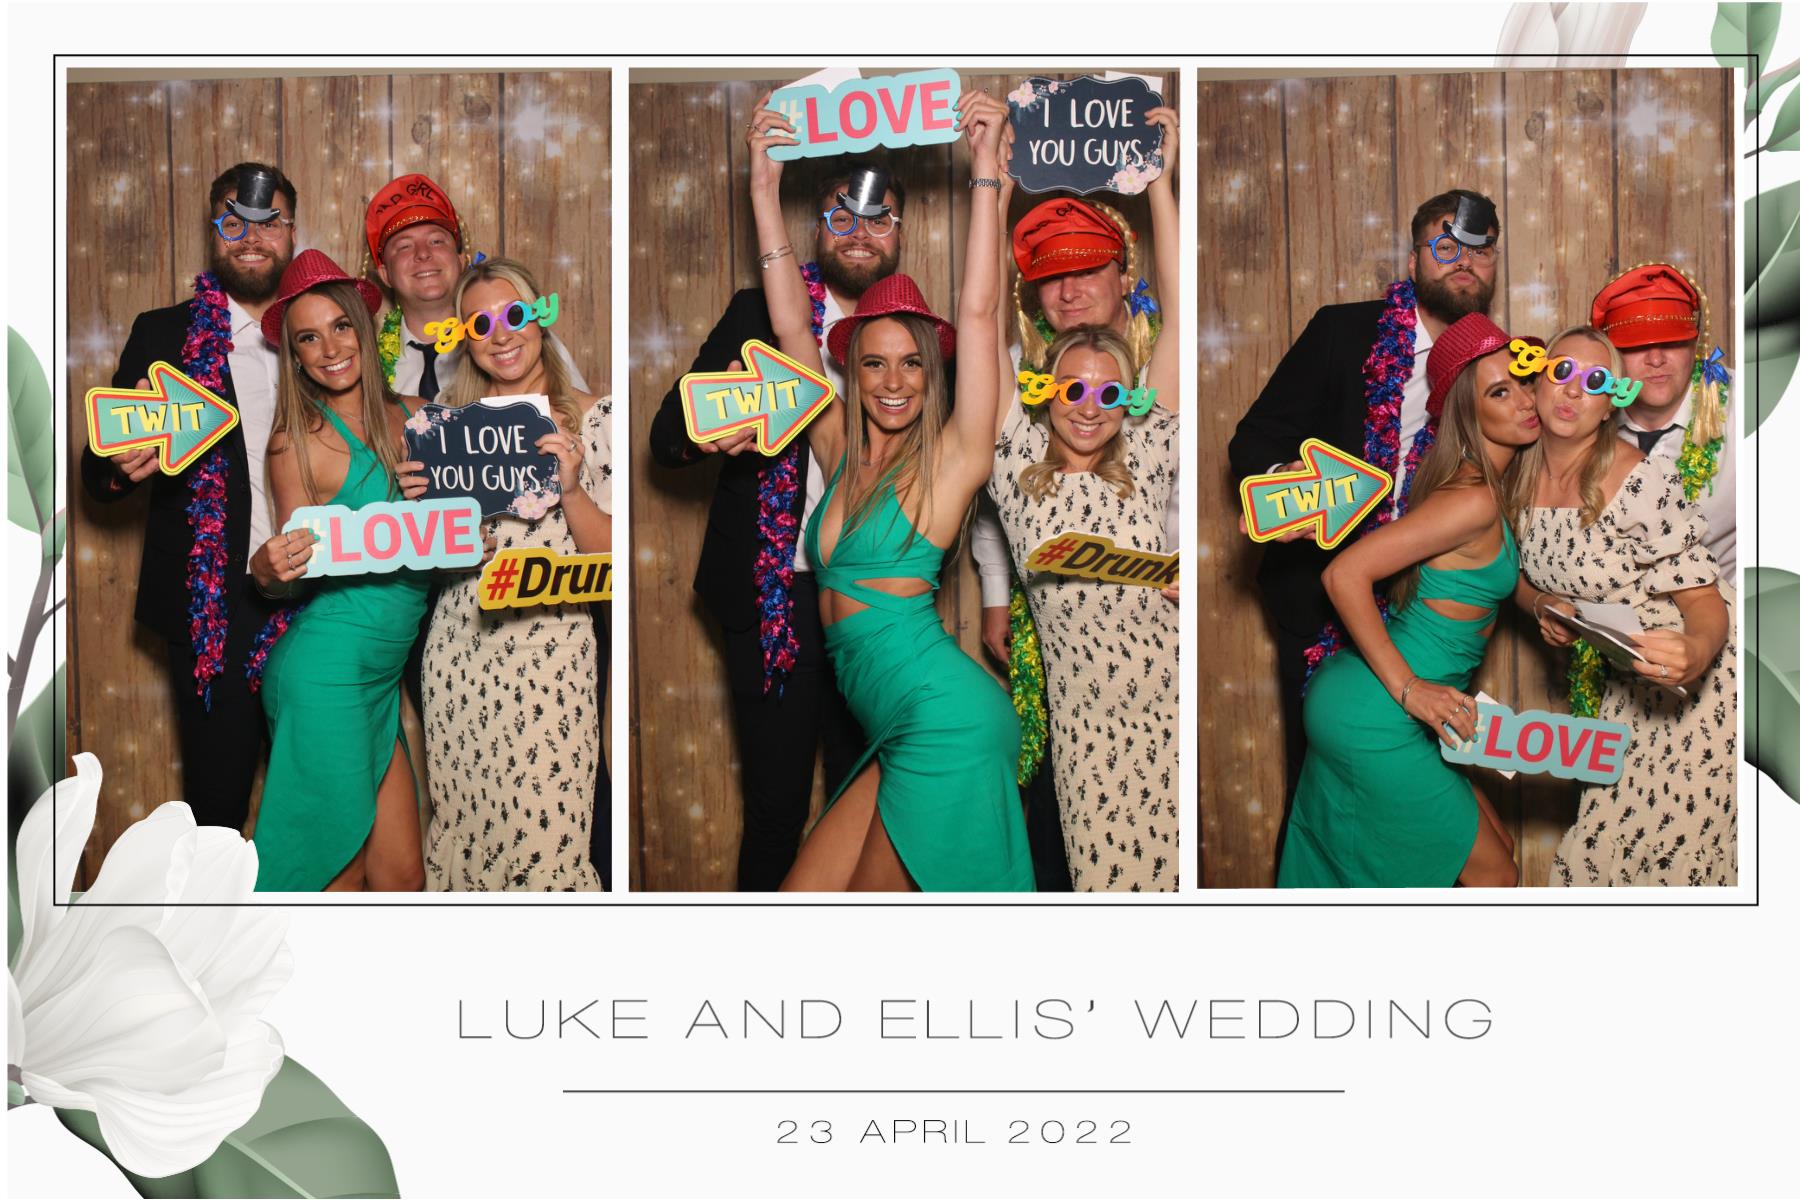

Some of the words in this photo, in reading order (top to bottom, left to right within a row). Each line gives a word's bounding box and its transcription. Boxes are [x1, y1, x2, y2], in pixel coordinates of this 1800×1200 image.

[1043, 98, 1050, 128] I
[1070, 98, 1134, 129] LOVE
[1029, 139, 1076, 166] YOU
[1084, 138, 1144, 167] GUYS
[705, 378, 800, 420] TWIT
[110, 402, 205, 435] TWIT
[439, 425, 447, 454] I
[464, 425, 528, 455] LOVE
[430, 465, 475, 492] YOU
[482, 464, 542, 493] GUYS
[1265, 473, 1359, 519] TWIT
